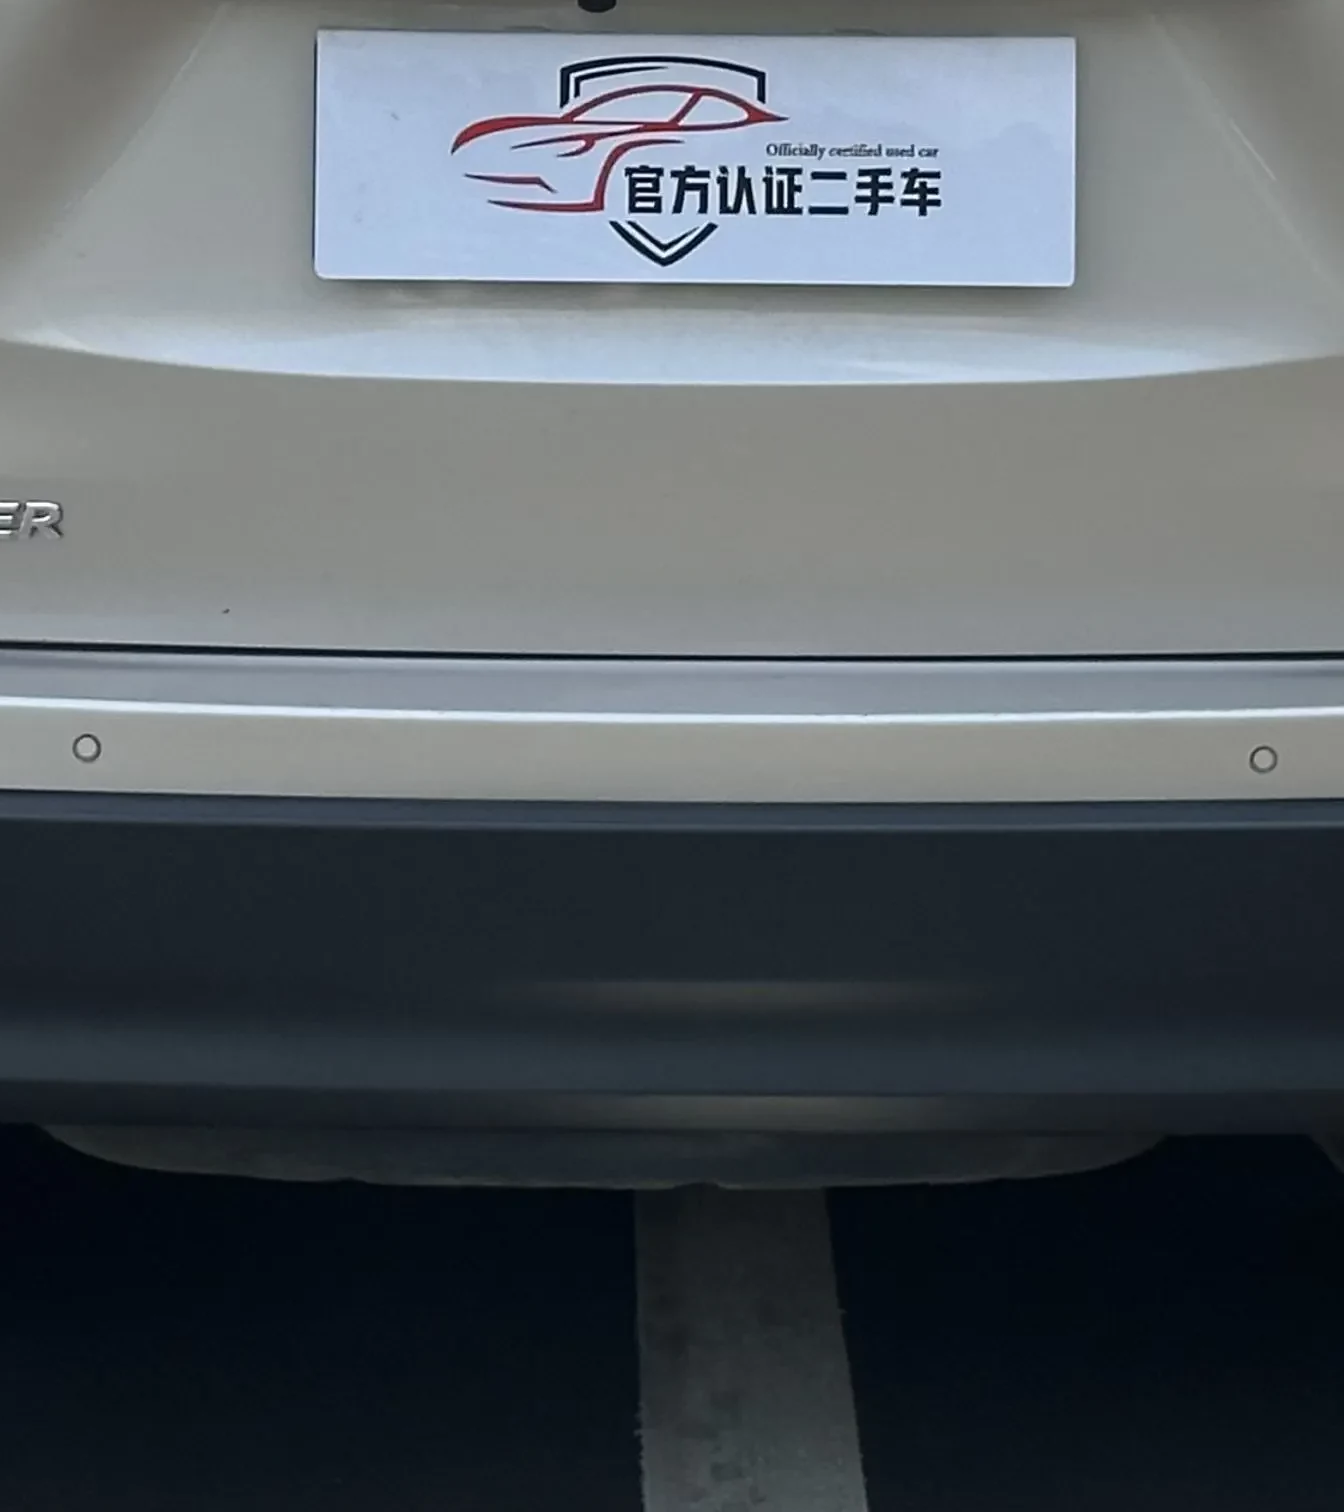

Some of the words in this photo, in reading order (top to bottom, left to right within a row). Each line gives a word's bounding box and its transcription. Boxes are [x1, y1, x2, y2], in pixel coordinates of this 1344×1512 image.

[766, 143, 825, 160] Officially
[829, 143, 882, 157] certified
[885, 144, 915, 157] used
[918, 147, 939, 157] car
[623, 164, 942, 217] 官方认证二手车
